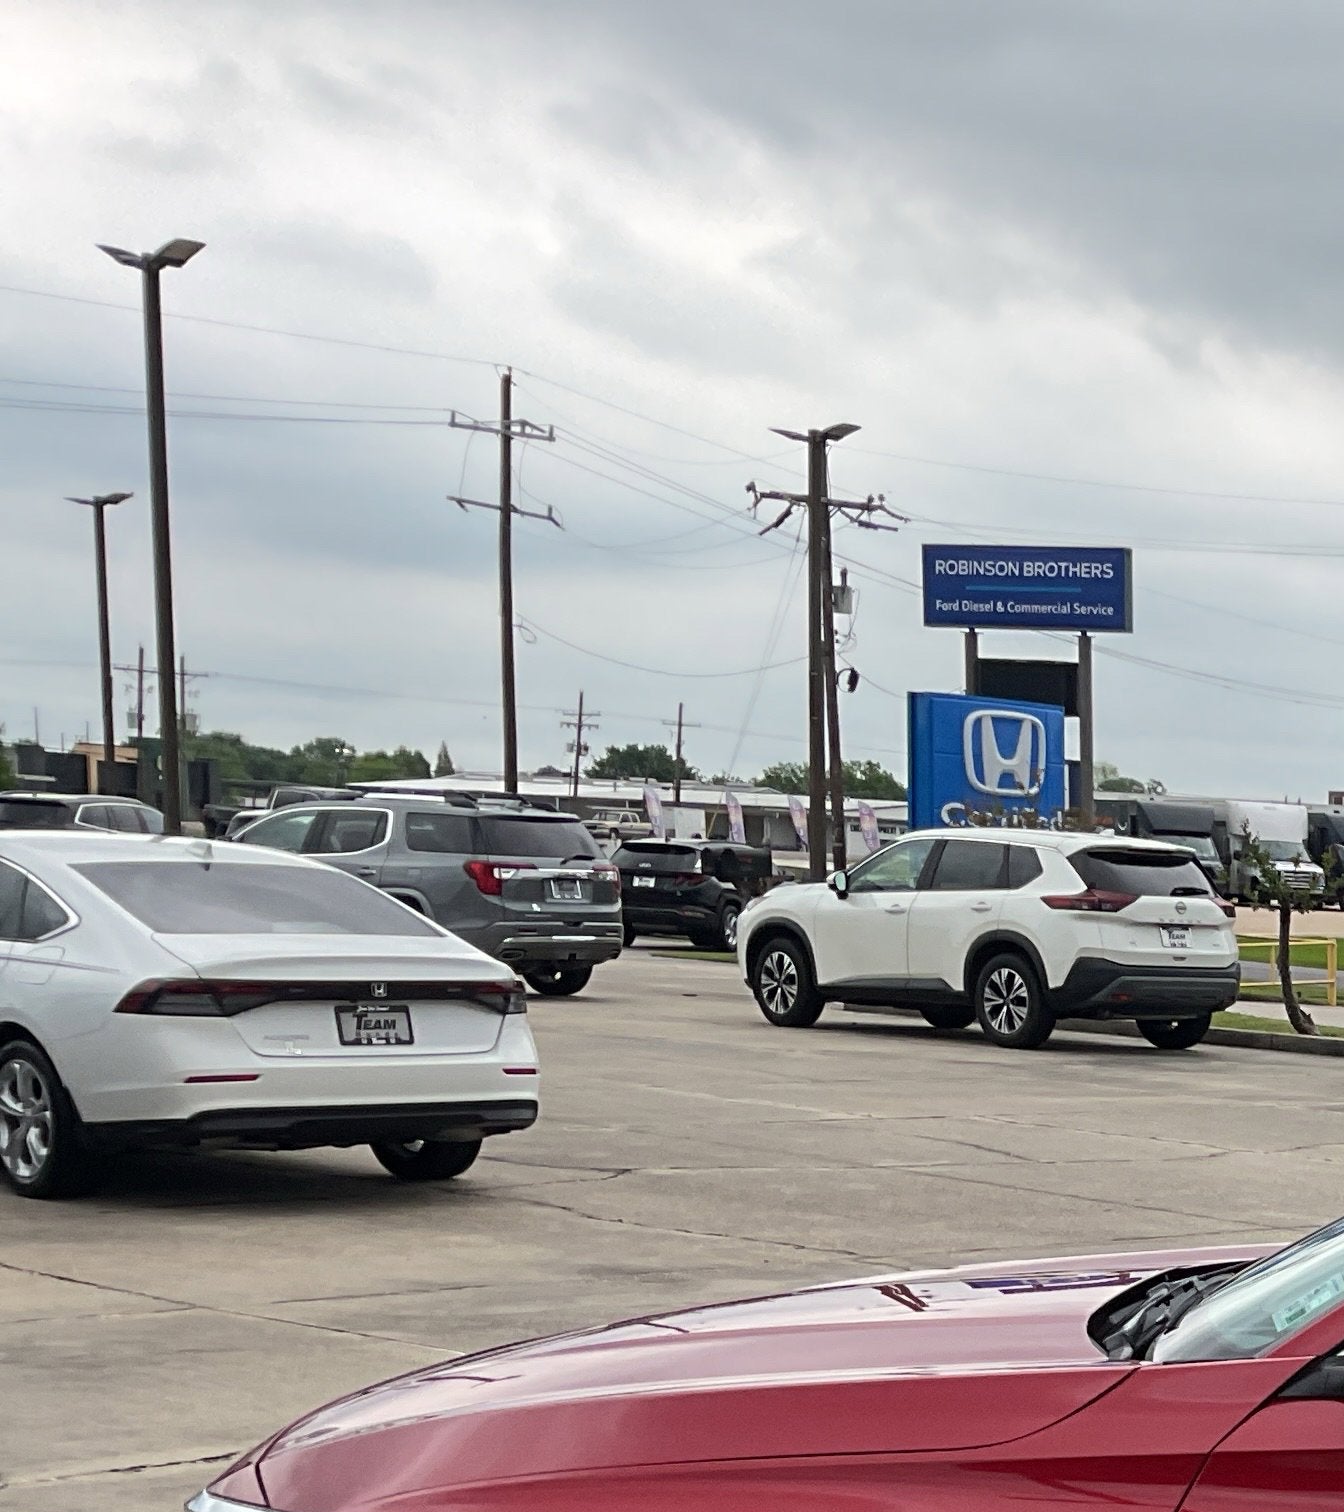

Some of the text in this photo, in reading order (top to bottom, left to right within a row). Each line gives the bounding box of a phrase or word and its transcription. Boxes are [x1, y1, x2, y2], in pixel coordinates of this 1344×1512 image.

[935, 559, 1114, 579] ROBINSON BROTHERS
[935, 600, 1115, 616] Ford Diesel & Commercial Service
[352, 1012, 397, 1031] TEAM
